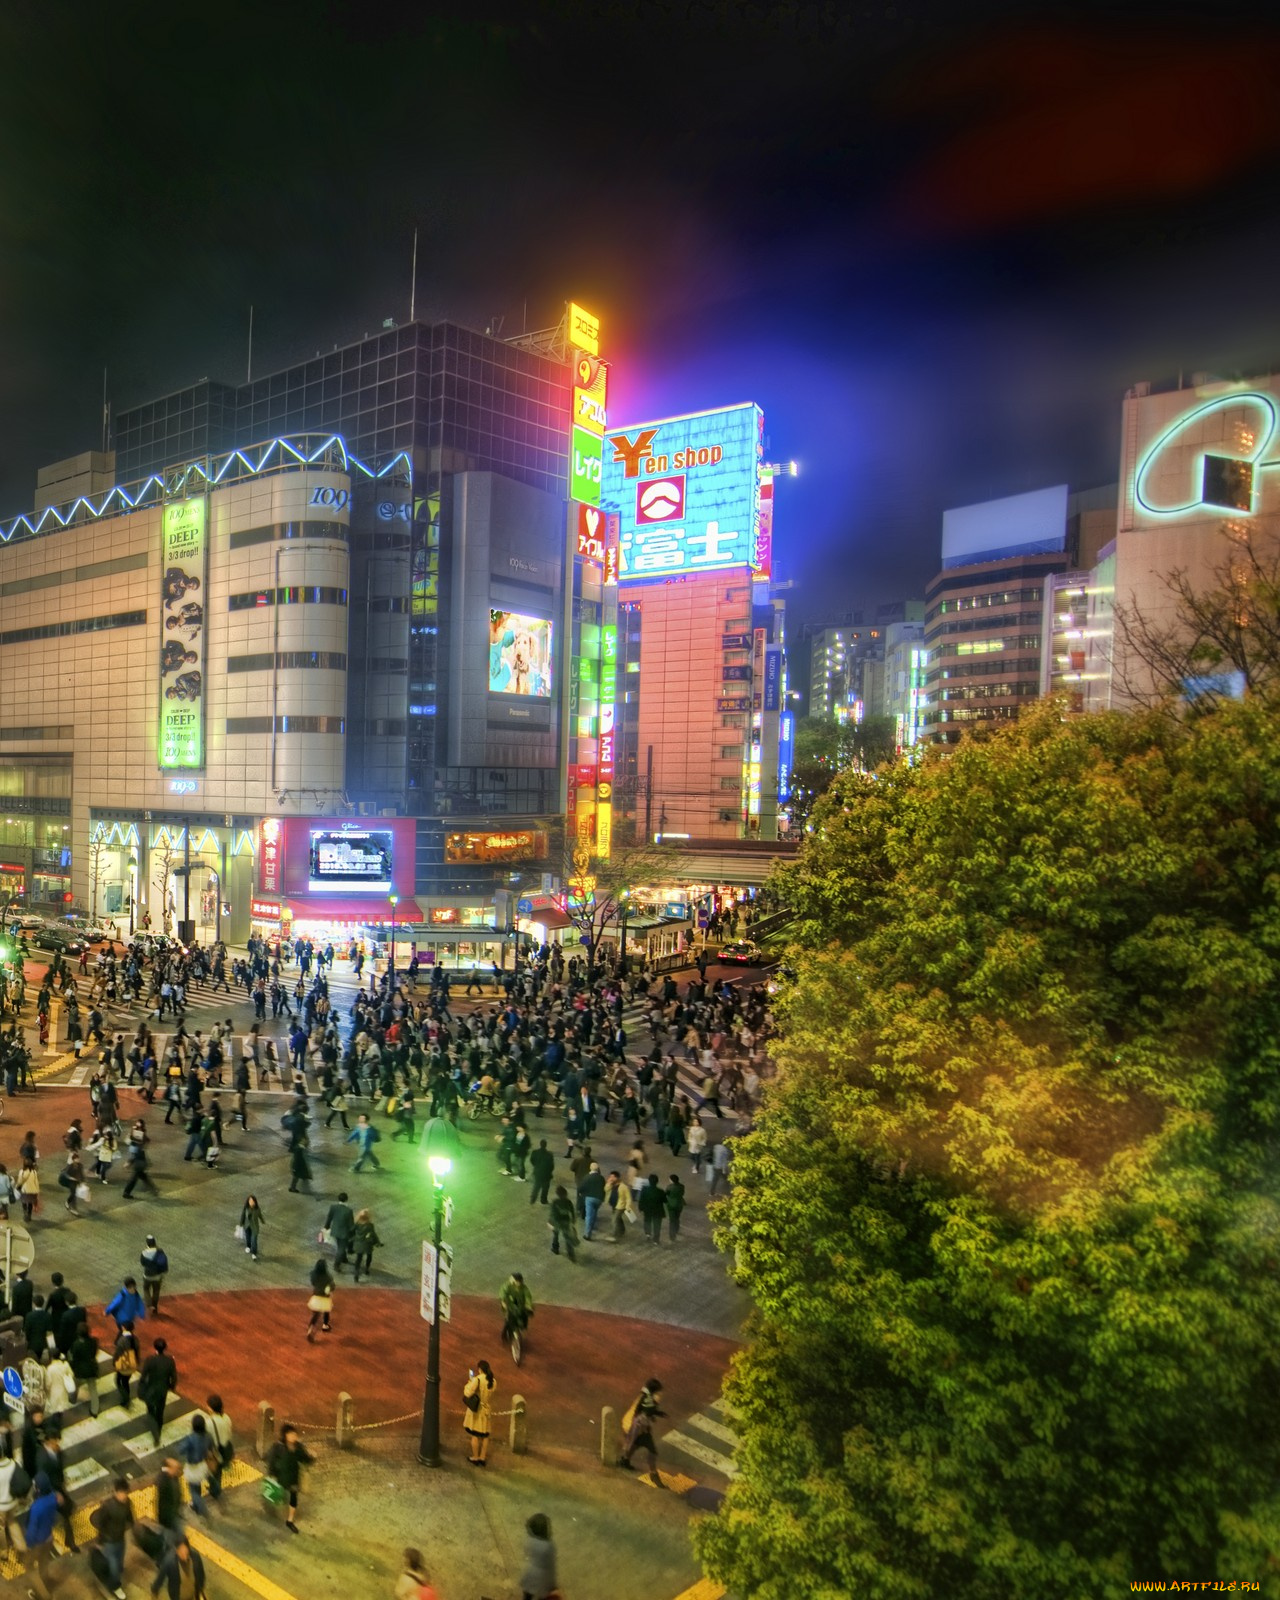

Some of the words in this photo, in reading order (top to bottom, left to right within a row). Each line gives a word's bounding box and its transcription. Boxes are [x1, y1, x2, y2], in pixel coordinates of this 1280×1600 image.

[575, 448, 603, 483] レイク
[673, 444, 723, 471] shop
[169, 528, 199, 545] DEEP
[168, 551, 179, 561] 3/3
[180, 547, 199, 558] drop!!
[768, 655, 776, 680] MIZUHO
[166, 714, 196, 726] DEEP
[782, 718, 790, 741] MIZUHO
